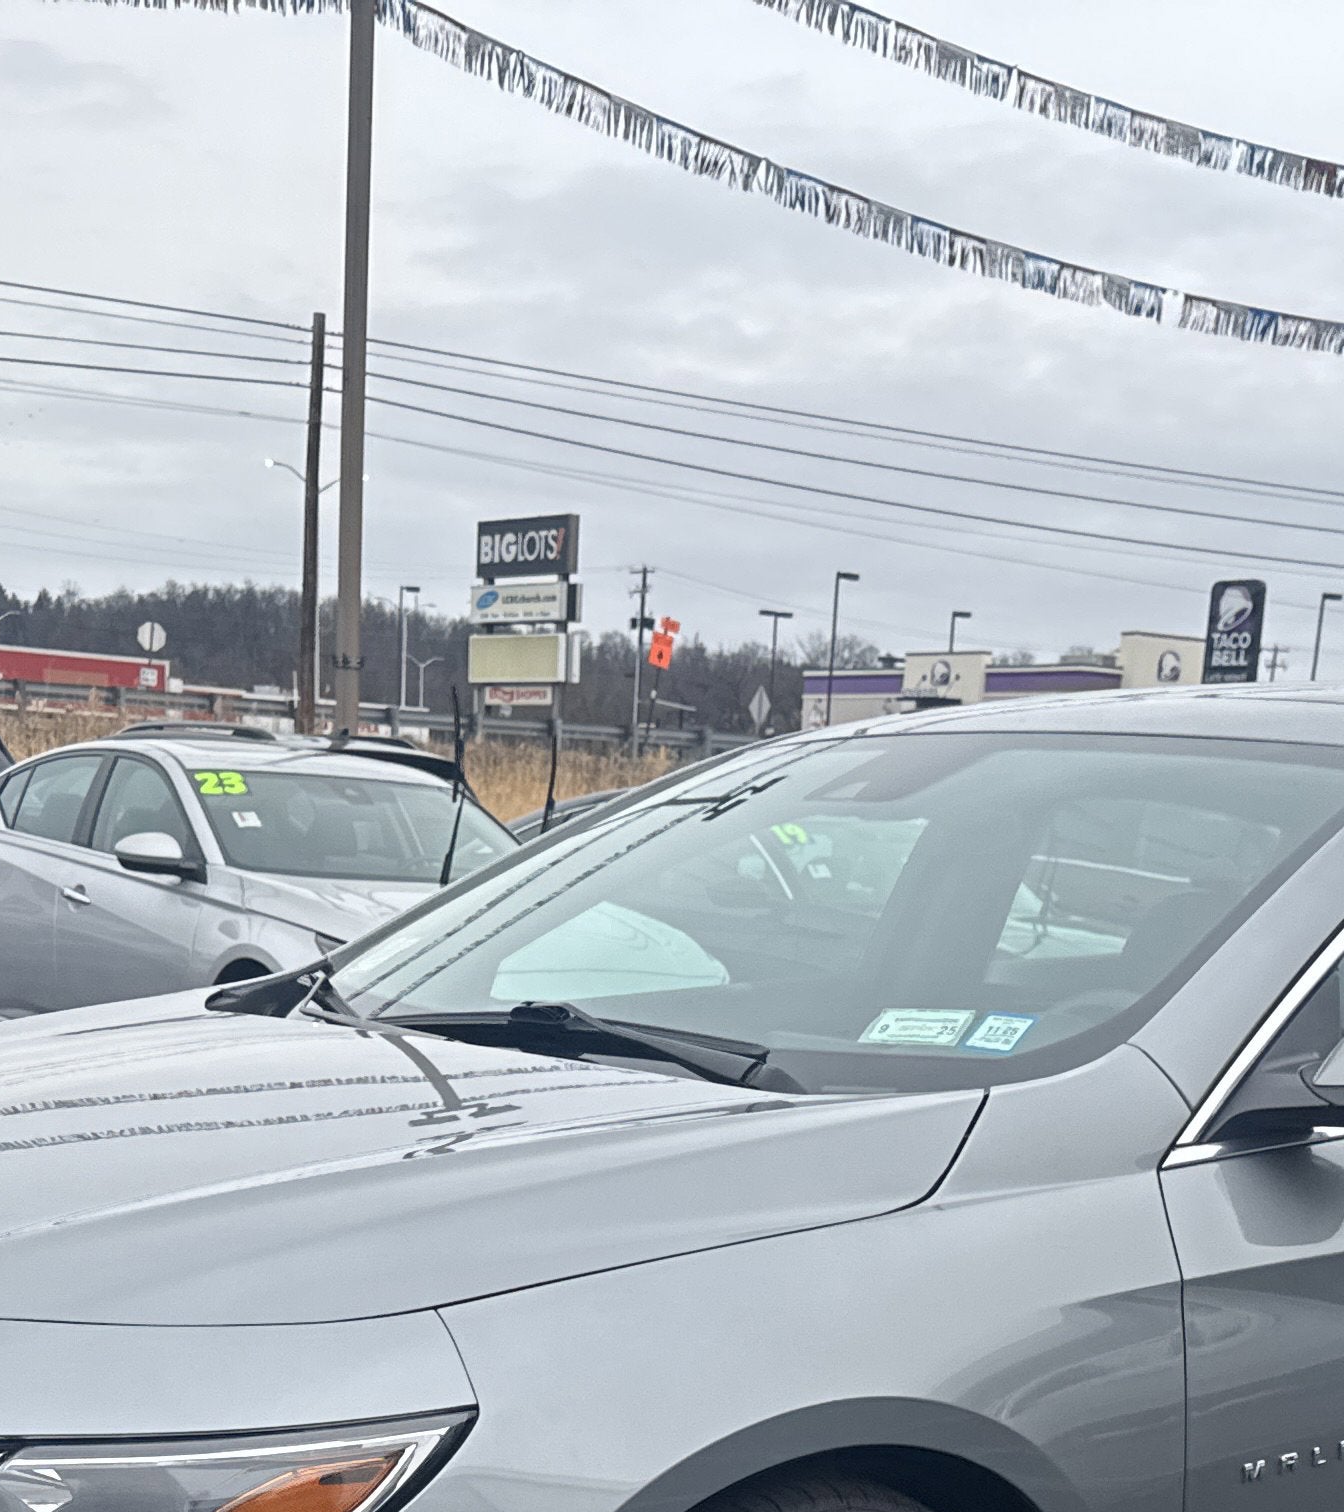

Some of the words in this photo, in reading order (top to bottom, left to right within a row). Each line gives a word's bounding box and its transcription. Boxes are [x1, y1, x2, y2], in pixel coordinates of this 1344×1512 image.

[1211, 631, 1252, 650] TACO
[1210, 650, 1249, 667] BELL
[194, 771, 249, 795] 23
[770, 823, 808, 846] 19
[878, 1023, 890, 1034] 9
[937, 1025, 958, 1036] 25
[1003, 1026, 1019, 1036] 25
